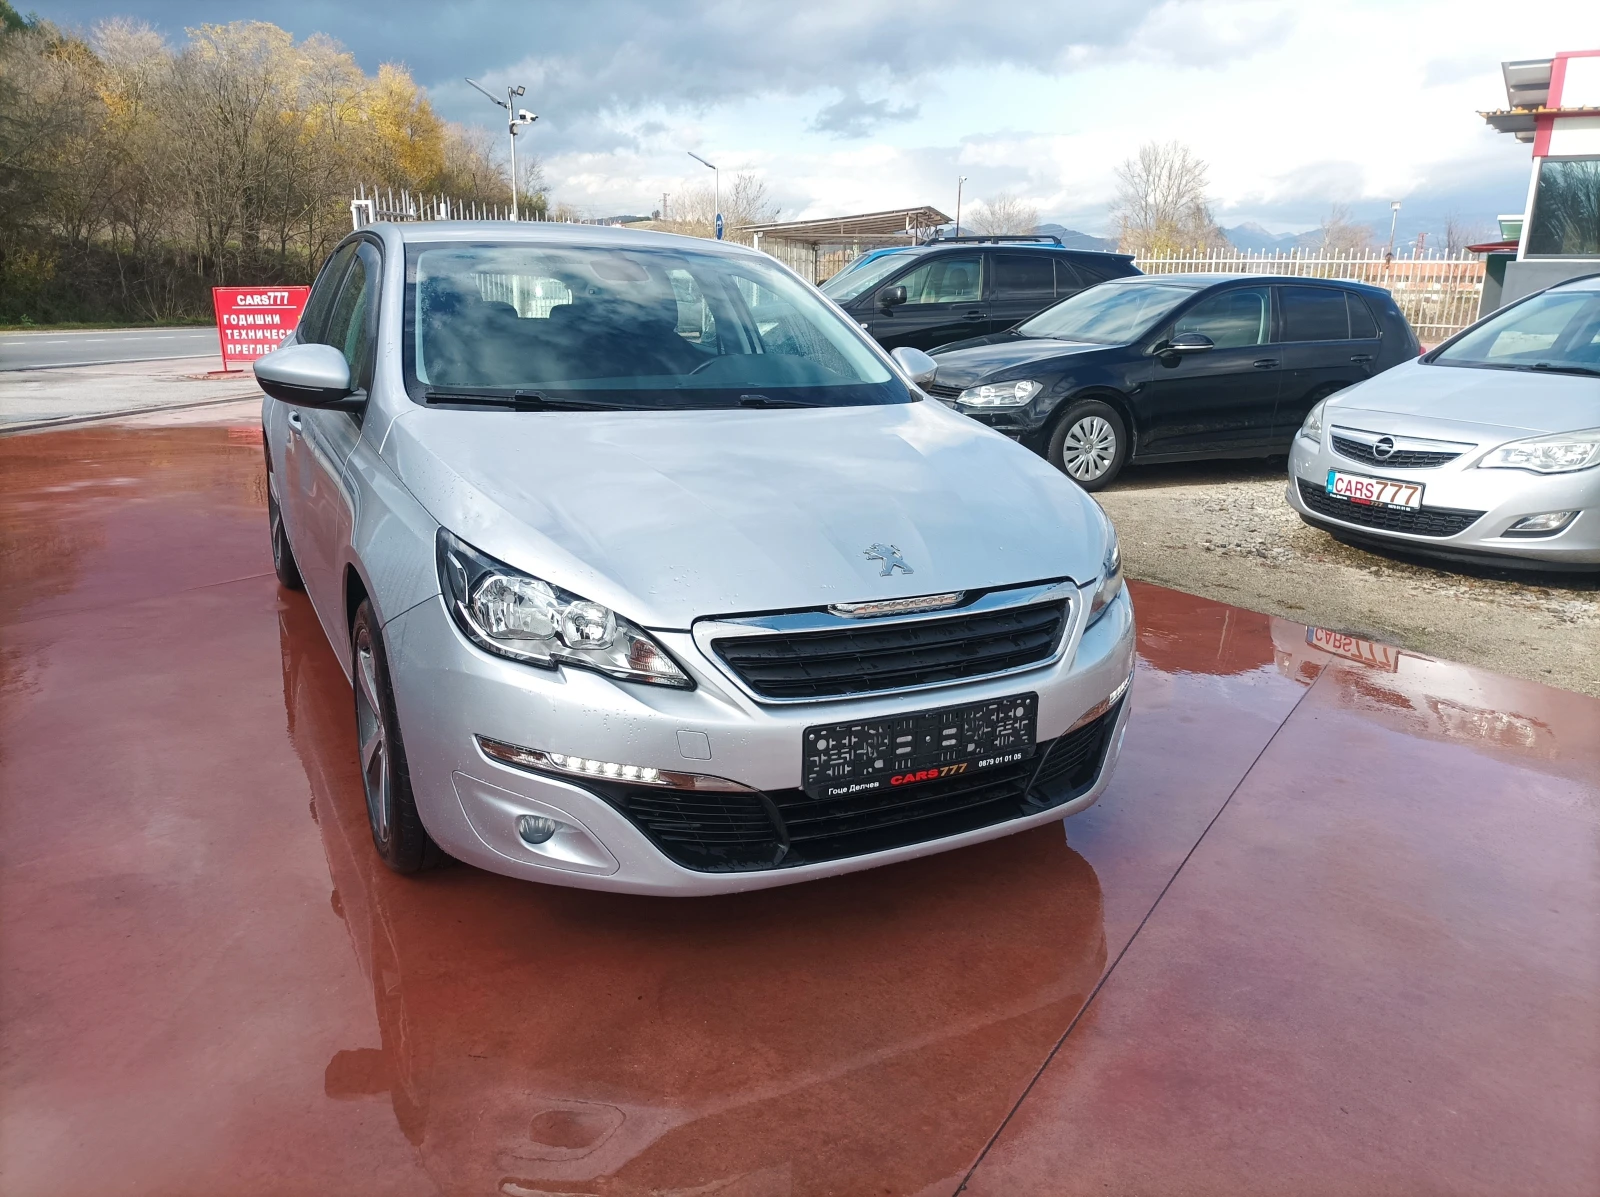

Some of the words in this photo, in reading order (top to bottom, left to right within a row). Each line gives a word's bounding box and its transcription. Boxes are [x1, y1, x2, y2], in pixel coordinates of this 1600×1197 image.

[236, 291, 289, 305] CARS777
[223, 314, 281, 326] ГОДИШНИ
[1335, 477, 1418, 505] CARS777
[978, 758, 995, 768] 0879
[995, 756, 1003, 765] 01
[1004, 754, 1012, 763] 01
[1013, 753, 1022, 761] 05
[890, 762, 968, 786] CARS777
[828, 786, 848, 796] Гоце
[849, 781, 880, 794] Делчев
